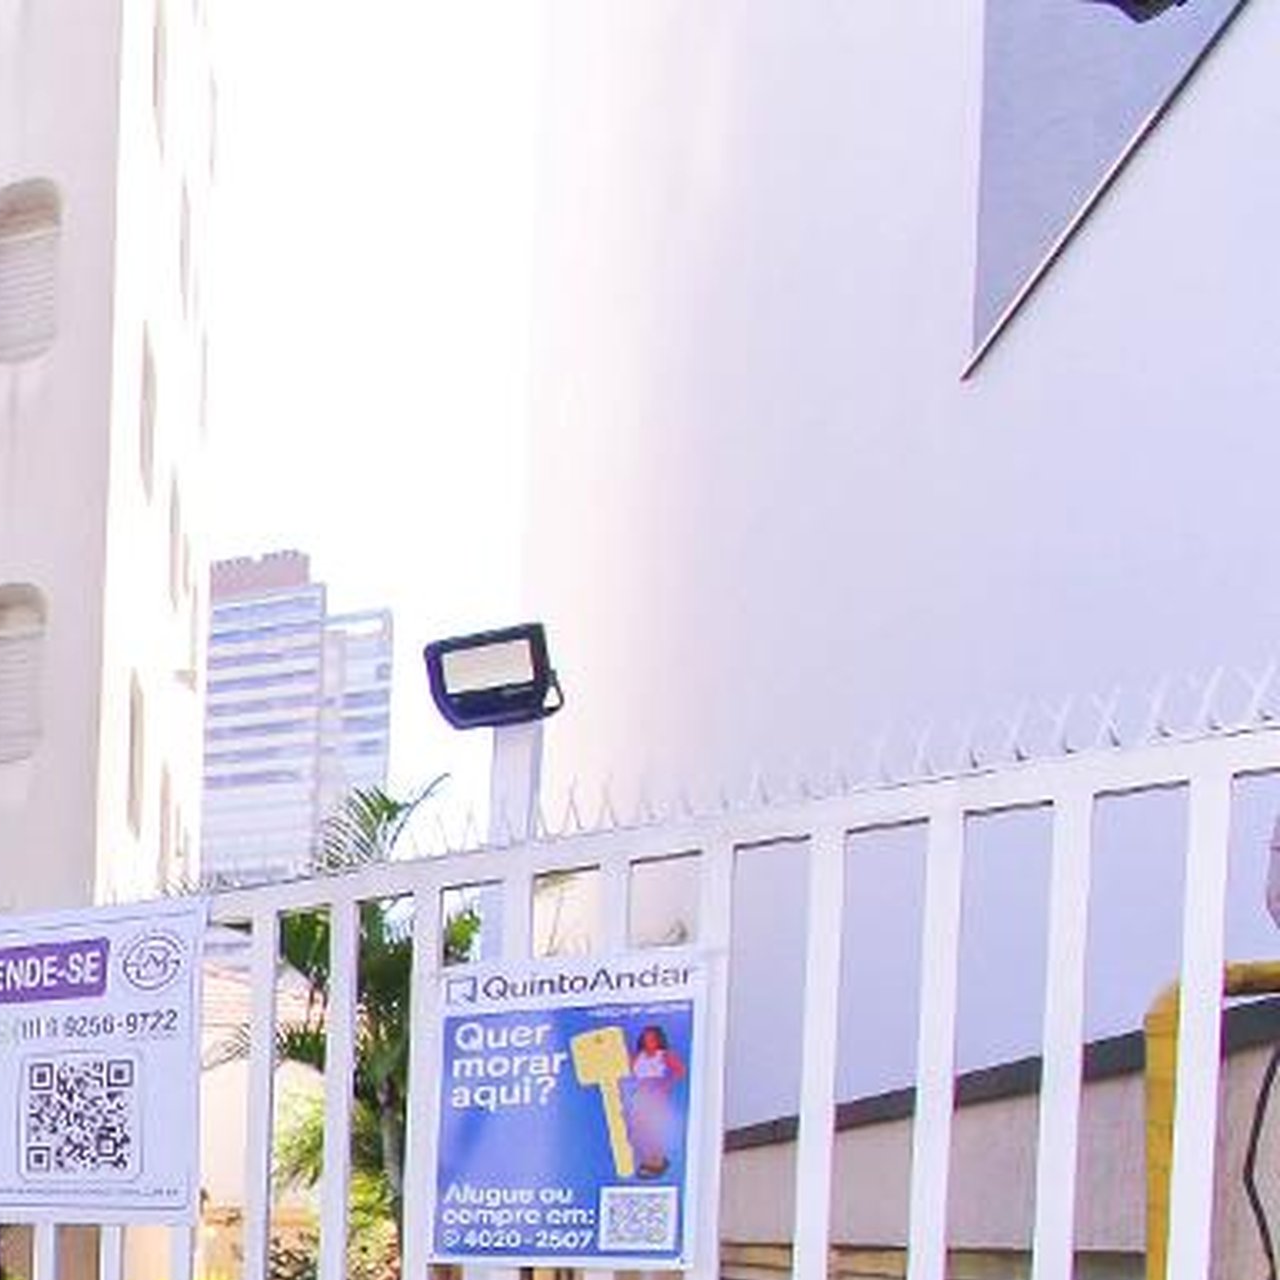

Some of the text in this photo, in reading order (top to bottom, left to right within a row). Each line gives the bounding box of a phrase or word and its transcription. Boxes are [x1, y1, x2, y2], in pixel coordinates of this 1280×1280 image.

[482, 966, 689, 1000] QuintoAndar
[453, 1022, 552, 1051] Quer
[452, 1053, 568, 1078] morar
[451, 1077, 557, 1111] aqui?
[443, 1183, 573, 1207] Alugue ou
[442, 1208, 595, 1227] compre em:
